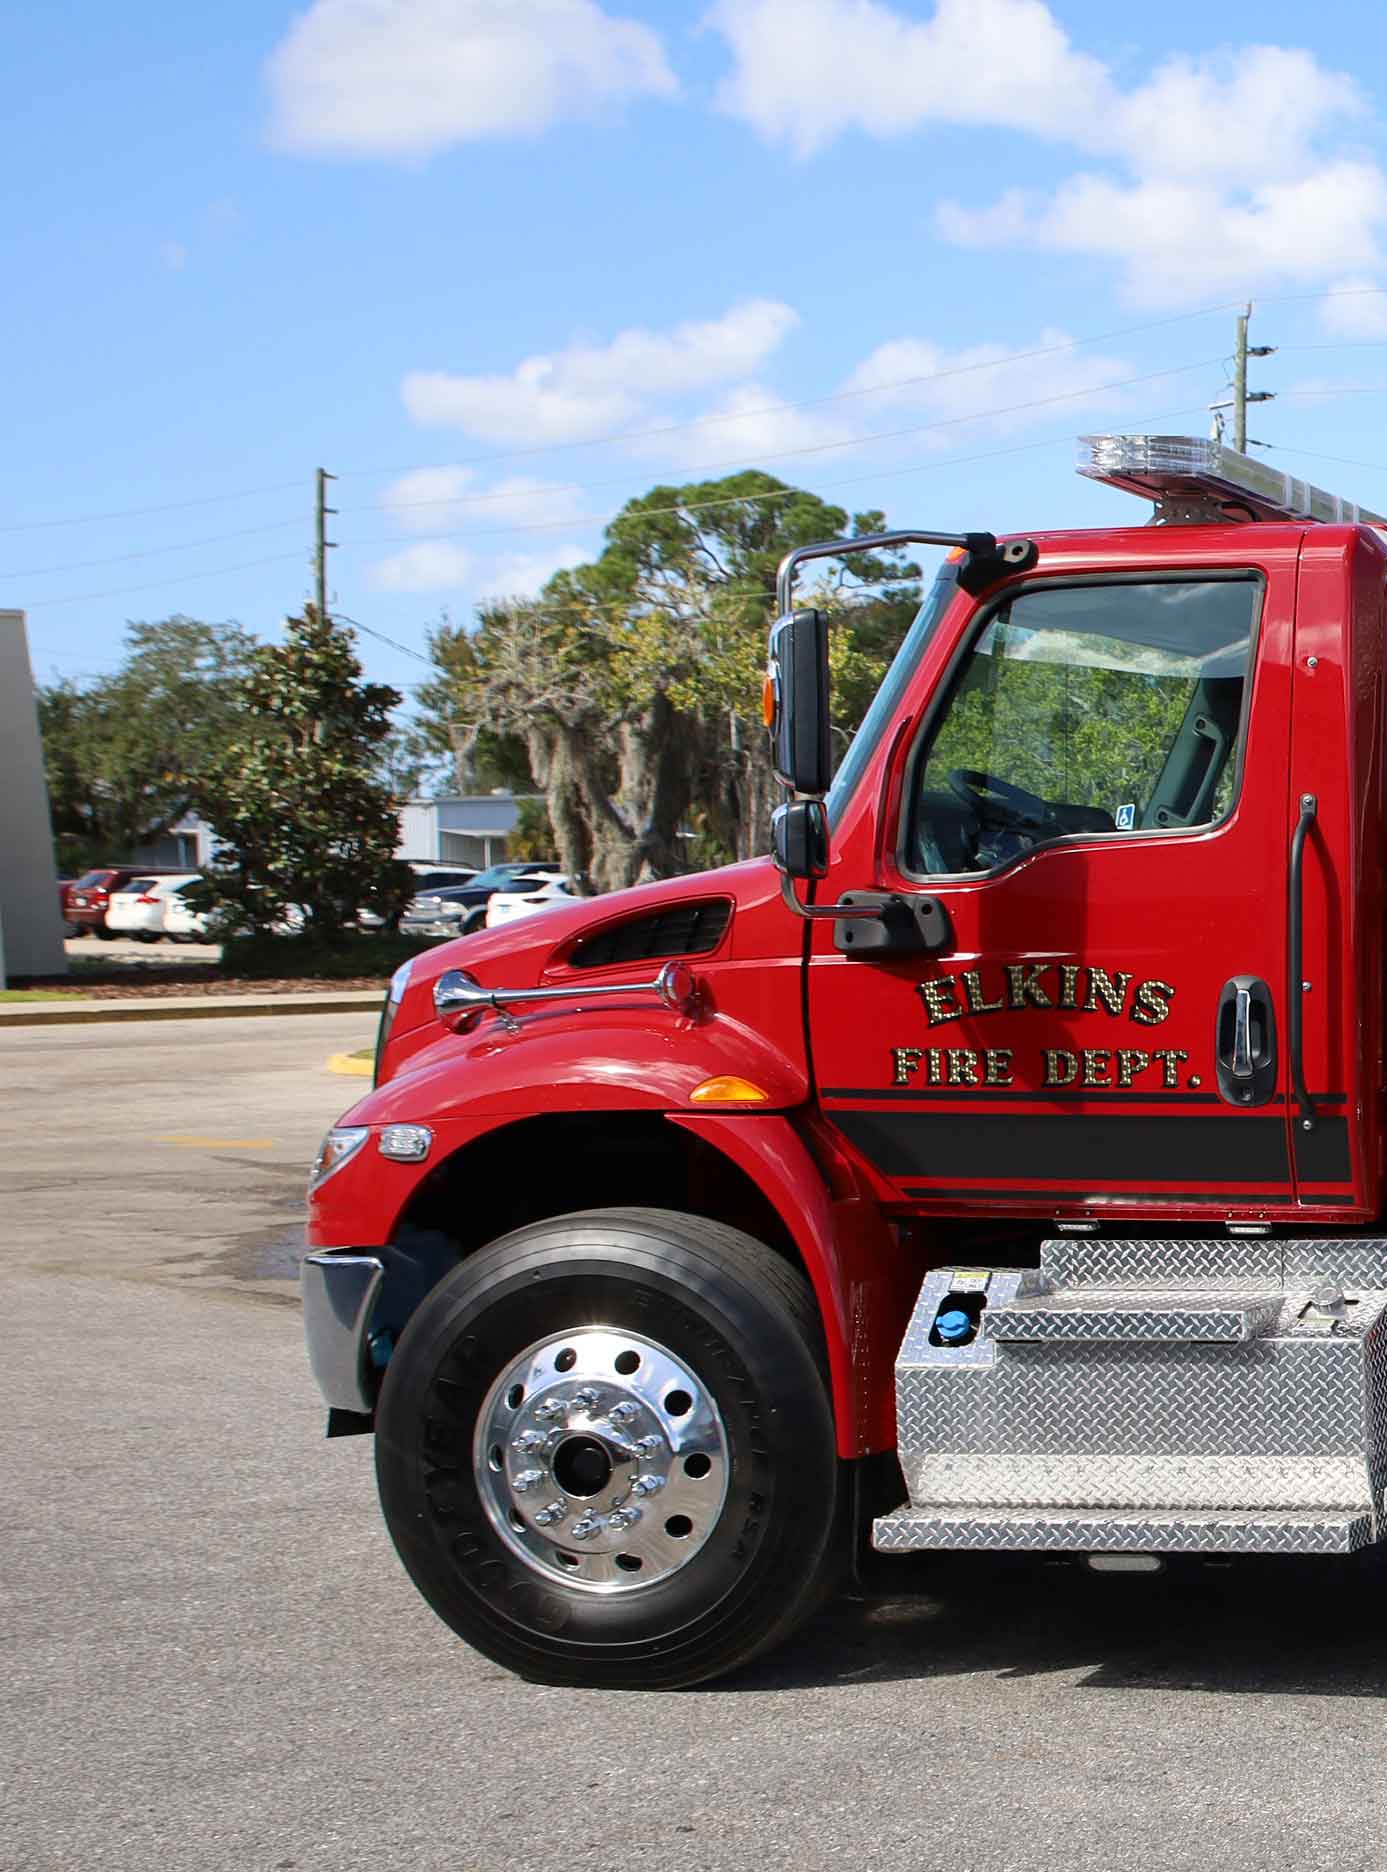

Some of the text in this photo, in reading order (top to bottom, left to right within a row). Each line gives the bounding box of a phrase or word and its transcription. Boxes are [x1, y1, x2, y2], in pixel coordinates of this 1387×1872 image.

[917, 964, 1176, 1027] ELKINS
[893, 1048, 1201, 1088] FIRE DEPT.
